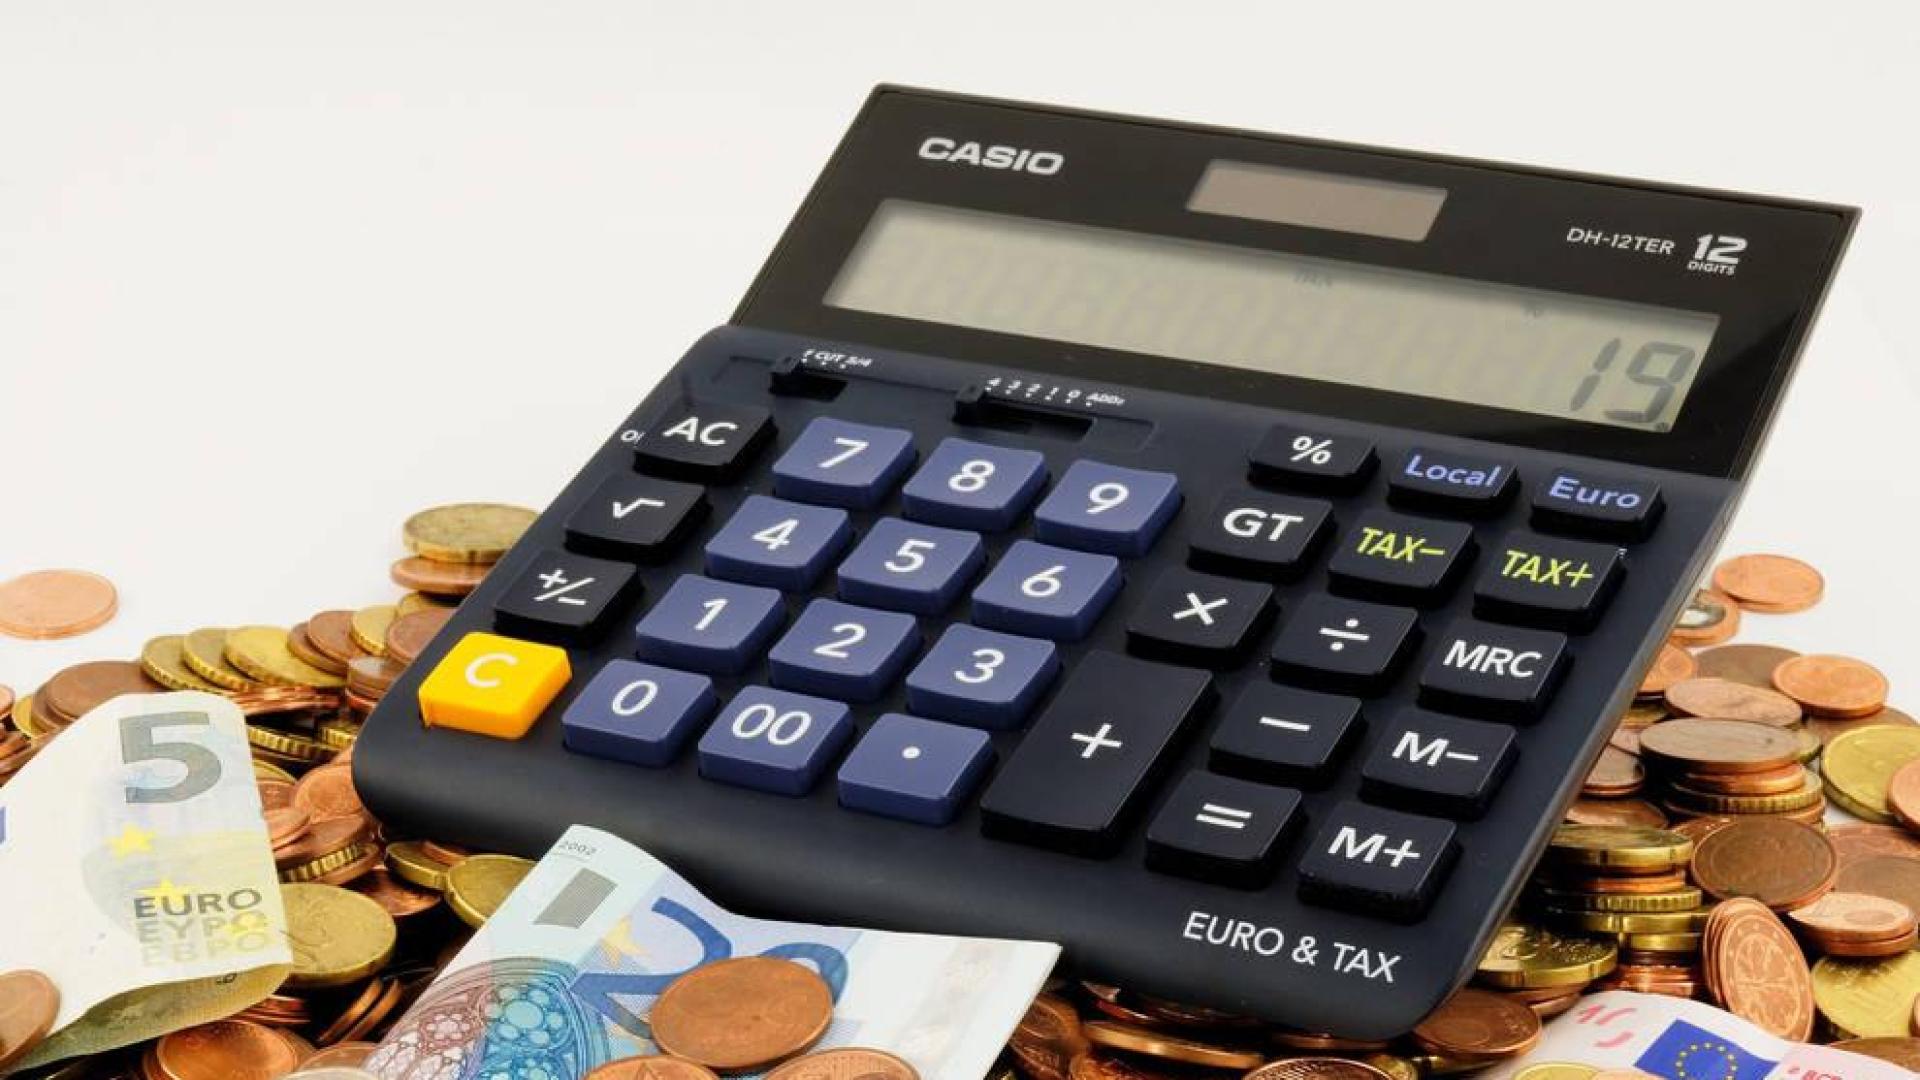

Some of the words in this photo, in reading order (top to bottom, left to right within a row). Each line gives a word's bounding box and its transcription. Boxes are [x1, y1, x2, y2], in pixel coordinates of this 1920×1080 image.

[918, 137, 1064, 175] CASIO
[1566, 227, 1675, 255] DH-12TER
[1694, 234, 1748, 265] 12
[1686, 260, 1738, 276] DIGITS
[663, 416, 738, 447] AC
[820, 437, 868, 468] 7
[1291, 435, 1332, 465] %
[948, 460, 996, 492] 8
[1405, 455, 1502, 487] Local
[1086, 482, 1129, 515] 9
[1549, 476, 1640, 509] Euro
[752, 519, 798, 550] 4
[1223, 507, 1304, 542] GT
[885, 538, 936, 573] 5
[1502, 550, 1593, 587] TAX+
[1021, 565, 1066, 598] 6
[695, 598, 728, 631] 1
[814, 623, 866, 659] 2
[464, 652, 518, 688] C
[955, 648, 1005, 684] 3
[1442, 639, 1543, 678] MRC
[612, 679, 658, 716] 0
[732, 703, 812, 746] 00
[119, 711, 222, 804] 5
[1327, 825, 1421, 868] M+
[133, 888, 263, 918] EURO
[1182, 911, 1285, 955] EURO
[1291, 935, 1319, 965] &
[1333, 942, 1401, 983] TAX
